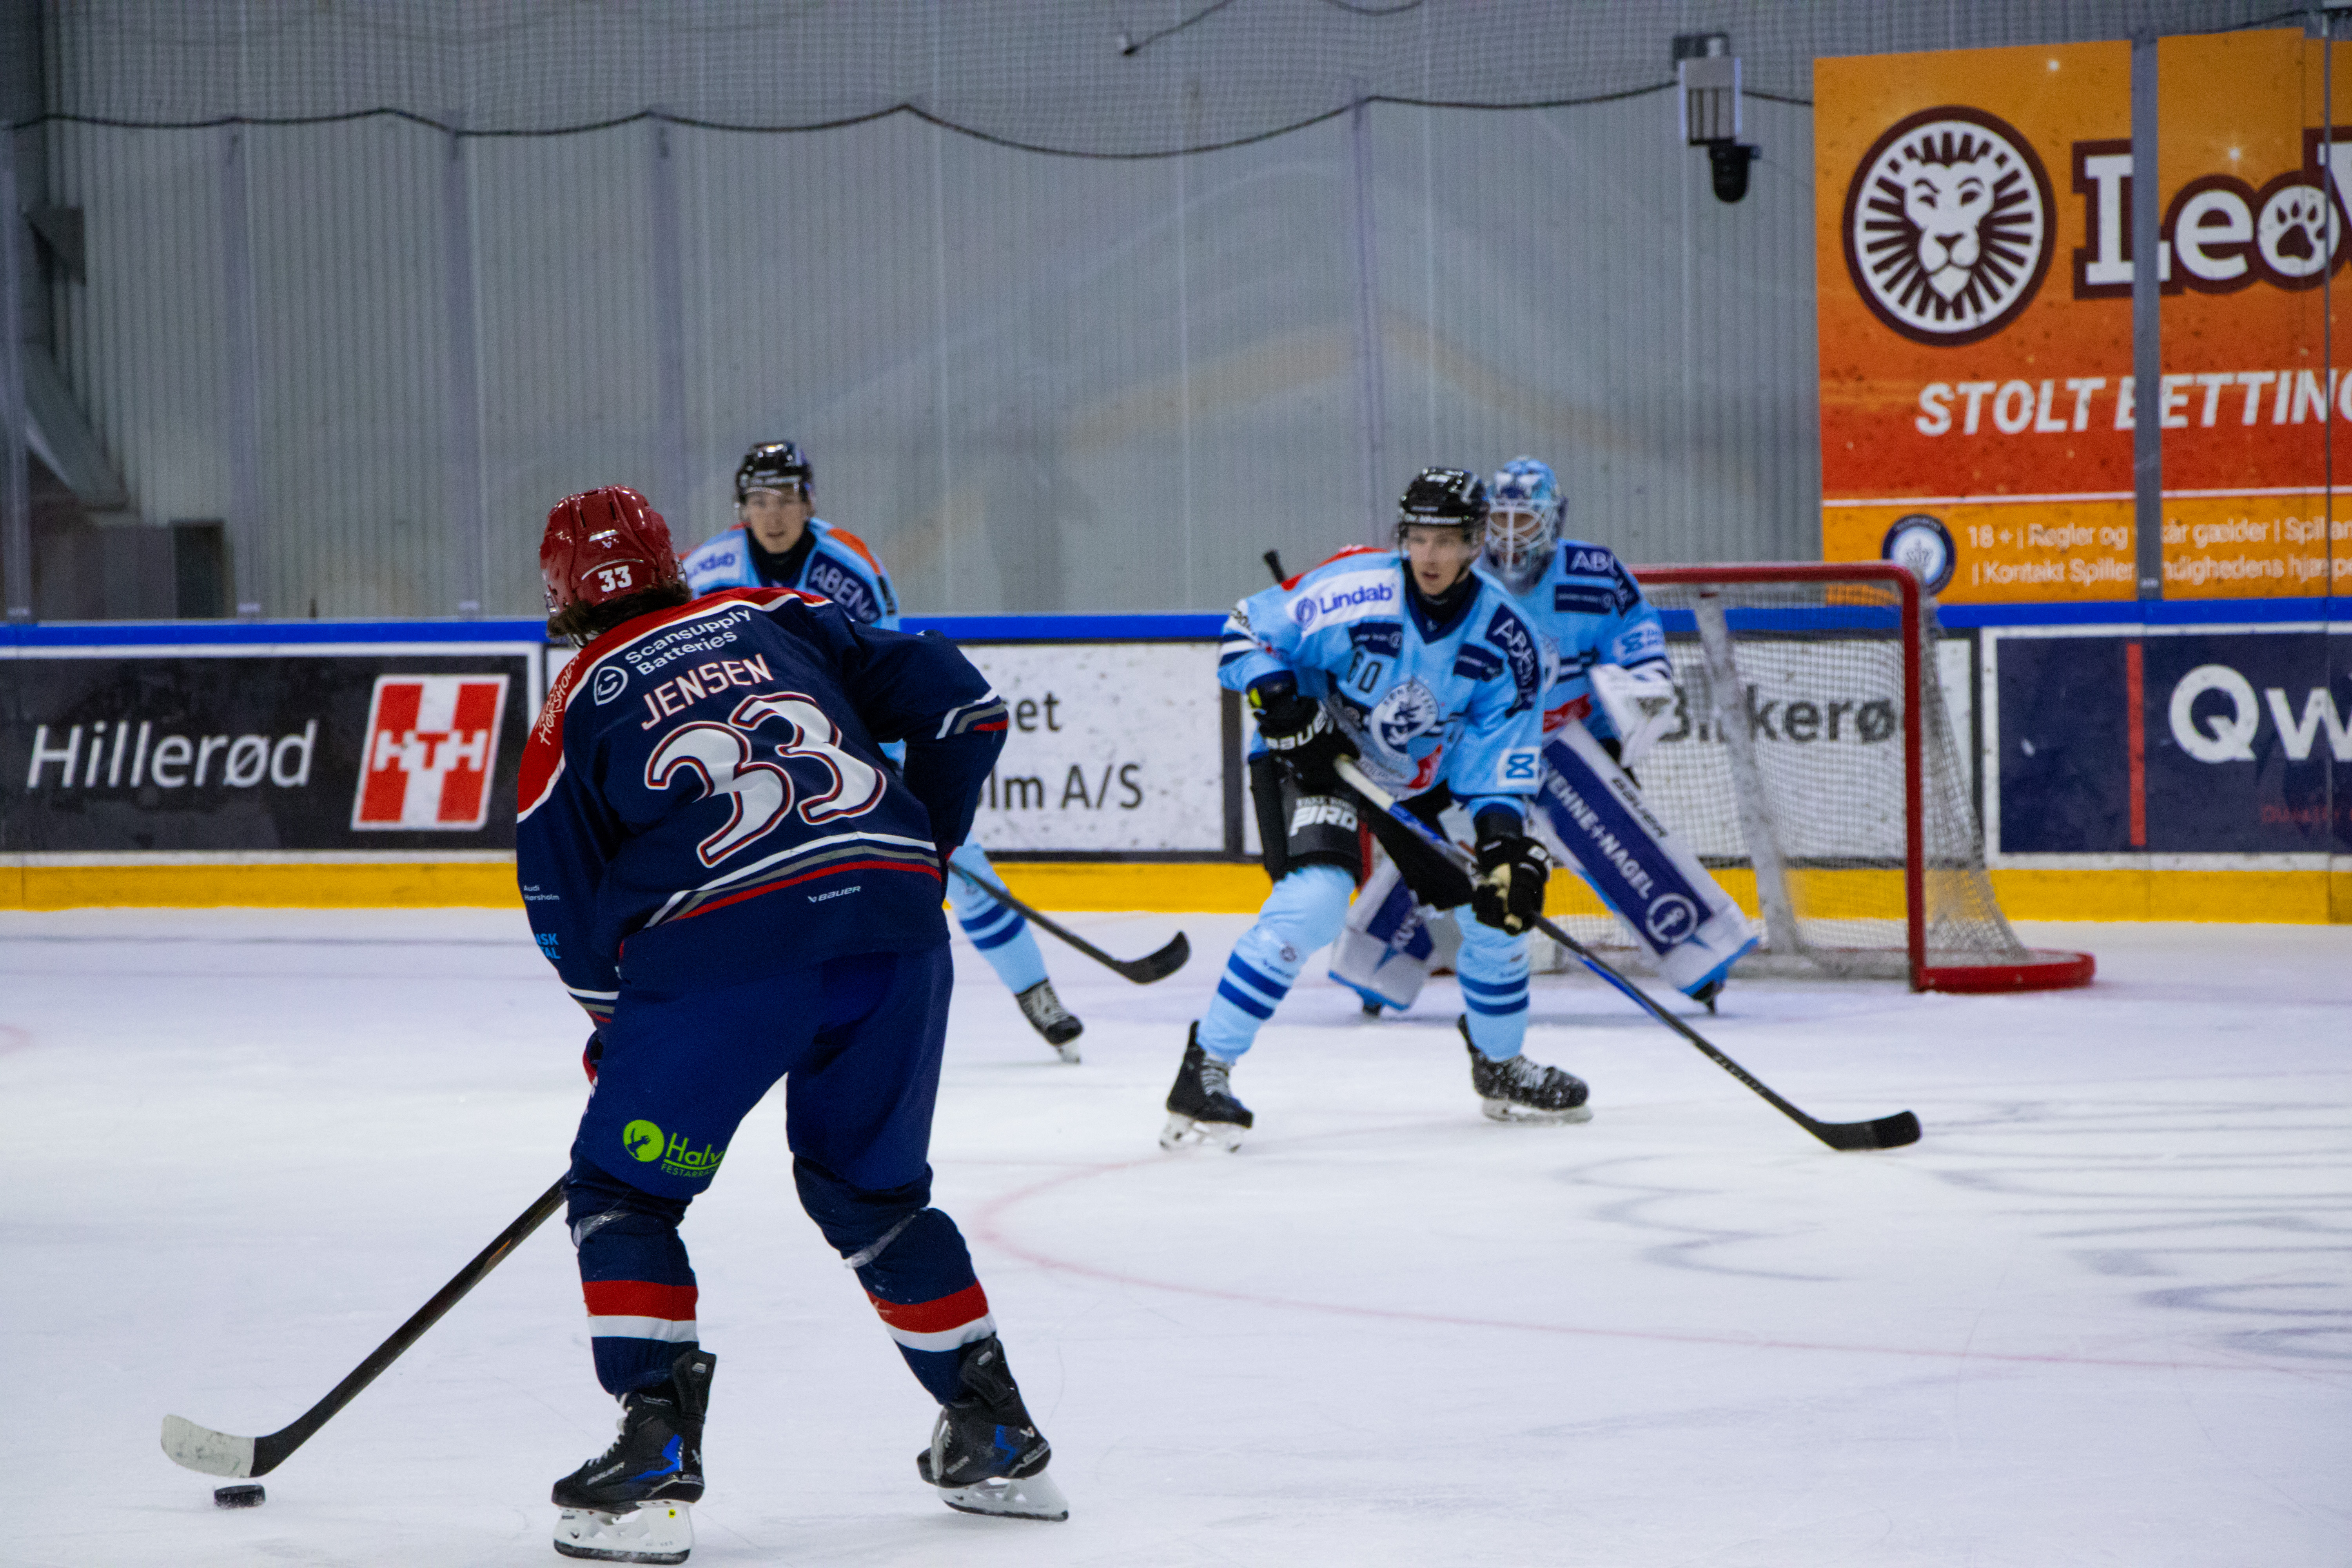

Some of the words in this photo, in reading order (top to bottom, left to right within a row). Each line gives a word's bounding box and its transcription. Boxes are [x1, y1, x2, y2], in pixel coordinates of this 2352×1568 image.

[1915, 377, 2107, 436] STOLT
[1967, 524, 1994, 549] 18
[2027, 522, 2096, 549] Regler
[2098, 526, 2128, 550] og
[598, 565, 632, 592] 33
[1983, 560, 2066, 583] Kontakt
[1319, 583, 1392, 615] Lindab
[624, 610, 751, 664] Scansupply
[636, 631, 738, 675] Batteries
[641, 653, 774, 730] JENSEN
[1002, 691, 1062, 733] et
[26, 719, 318, 788] Hillerød
[372, 730, 489, 772] HTH
[644, 691, 887, 869] 33
[978, 764, 1044, 810] lm
[1061, 763, 1143, 810] A/S
